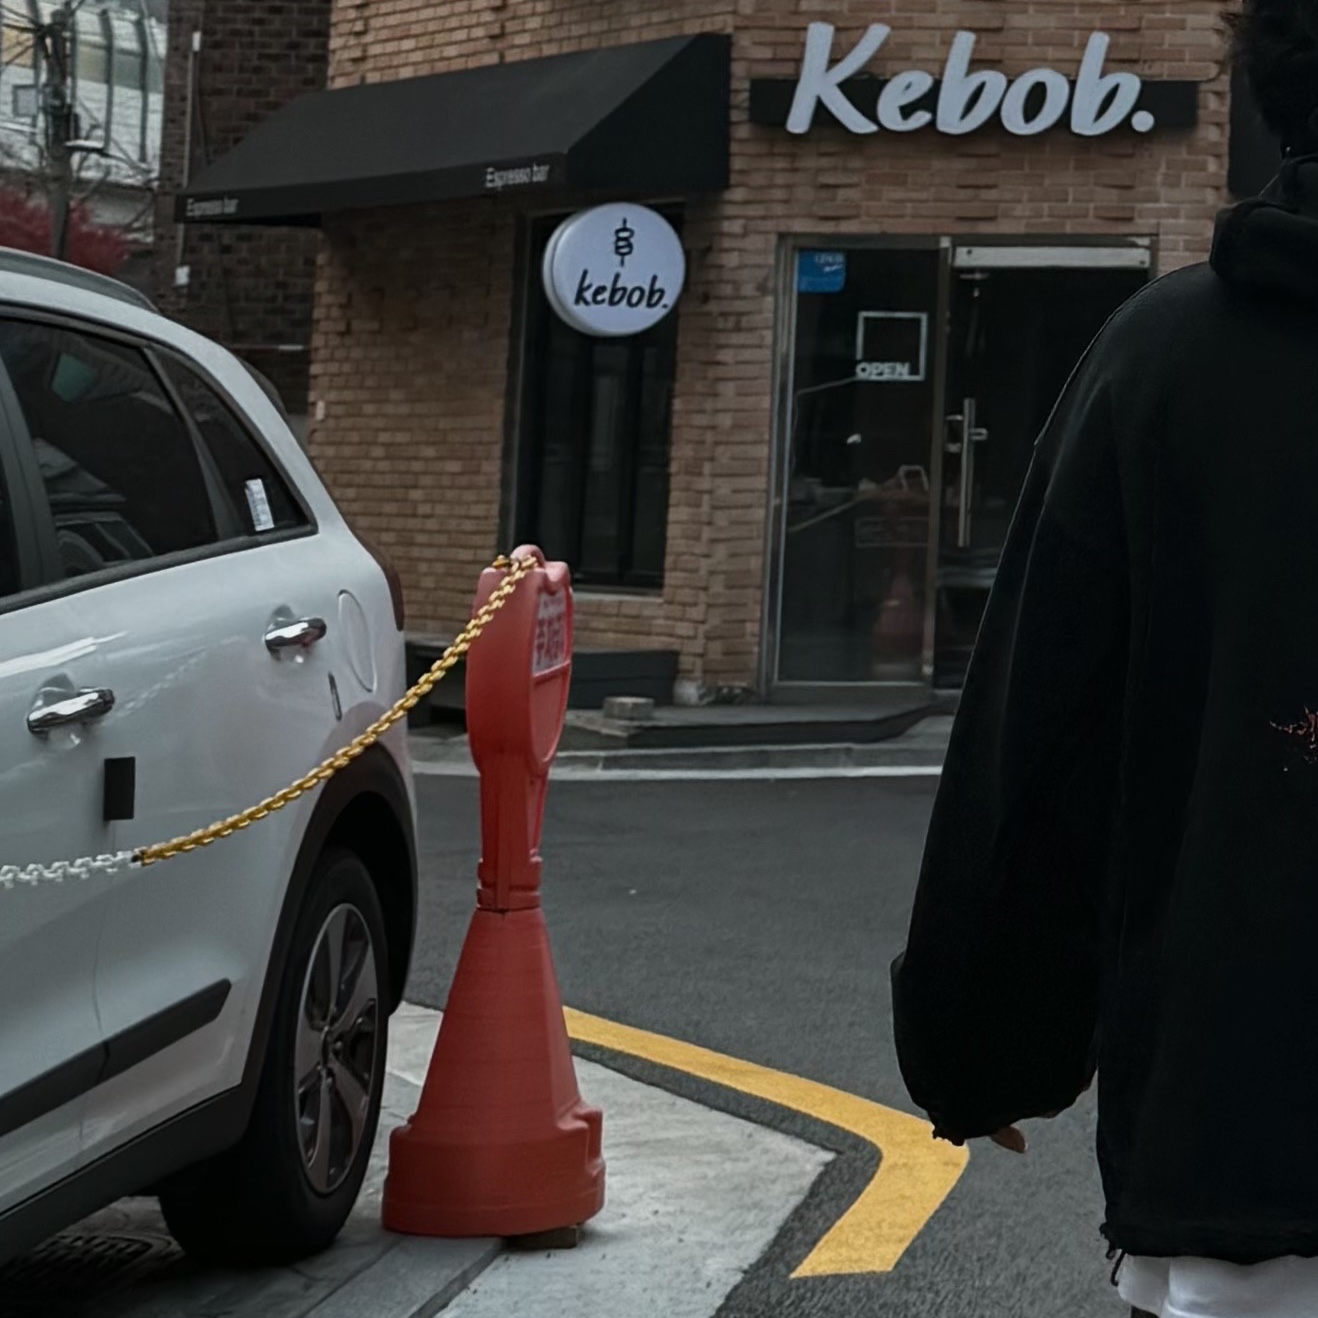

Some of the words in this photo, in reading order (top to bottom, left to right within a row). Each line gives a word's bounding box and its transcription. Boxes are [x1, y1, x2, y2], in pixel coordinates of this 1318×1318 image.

[786, 21, 1155, 136] Kebob.
[485, 167, 531, 191] Espresso
[532, 162, 550, 182] bar
[574, 268, 668, 309] kebob.
[855, 362, 910, 379] OPEN
